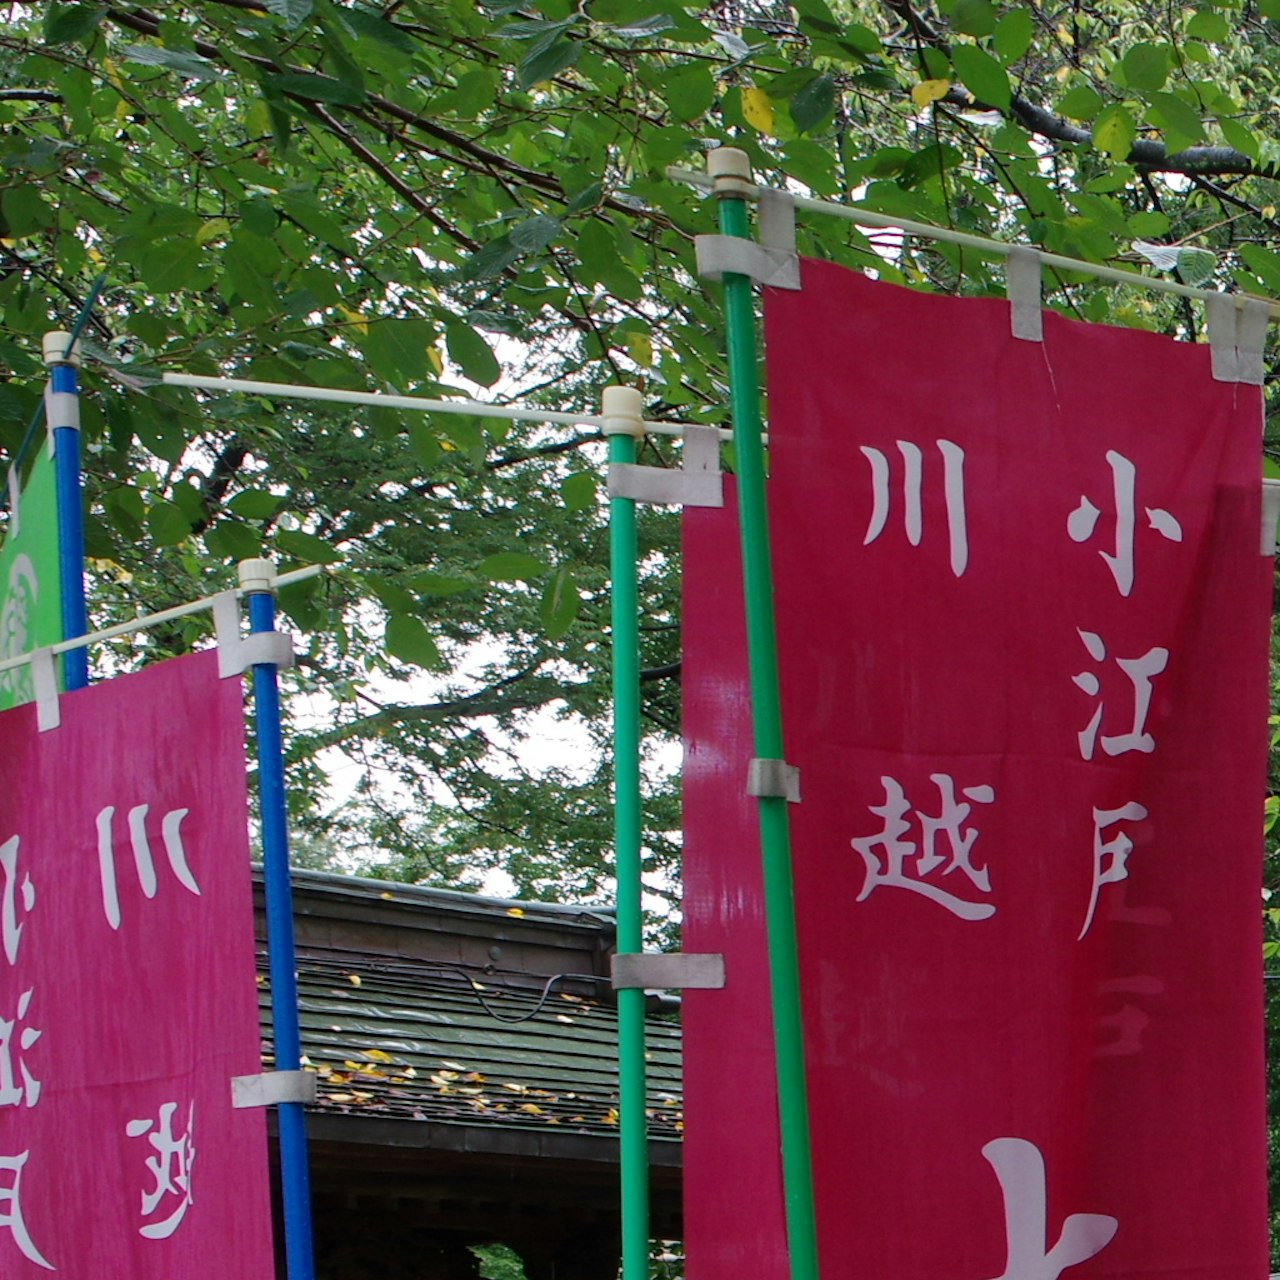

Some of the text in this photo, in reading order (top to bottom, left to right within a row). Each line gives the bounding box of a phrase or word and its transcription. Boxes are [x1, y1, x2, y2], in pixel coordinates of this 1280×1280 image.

[850, 438, 997, 921] 川越
[1067, 449, 1183, 942] 小江戸
